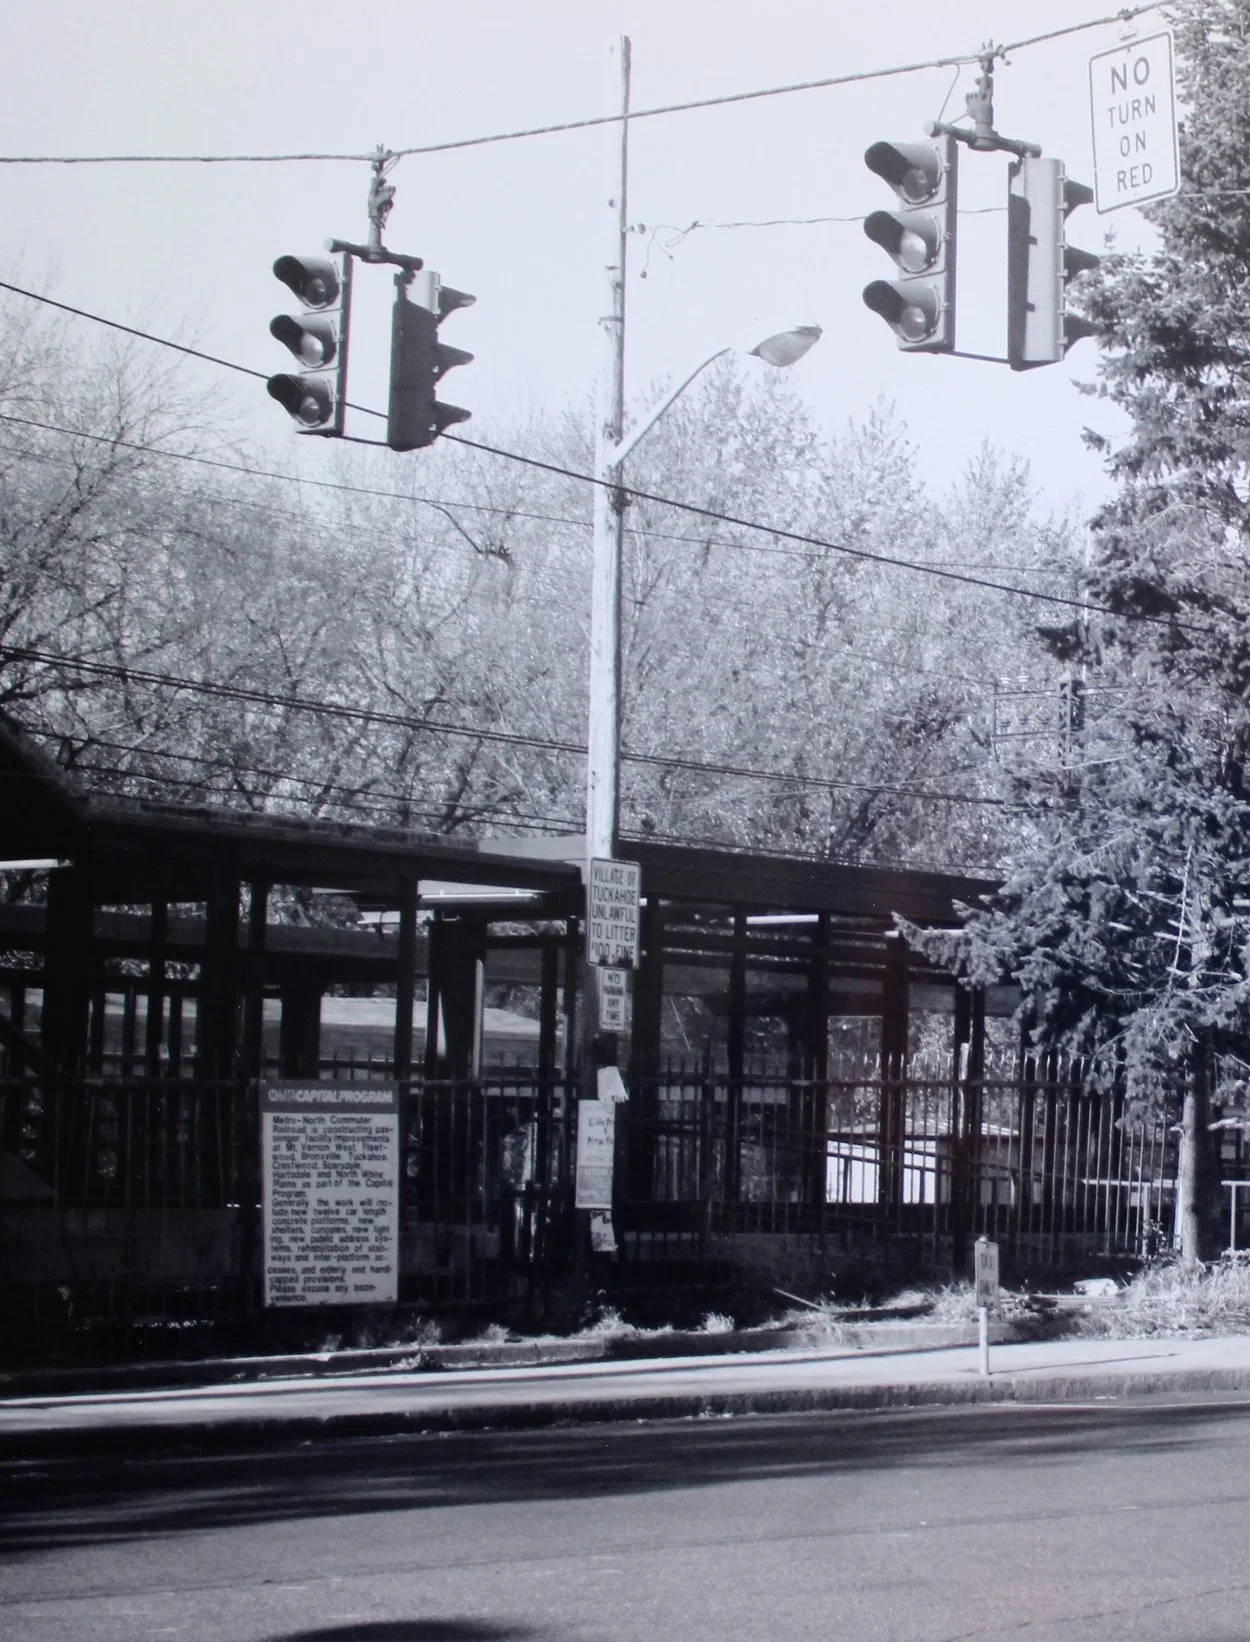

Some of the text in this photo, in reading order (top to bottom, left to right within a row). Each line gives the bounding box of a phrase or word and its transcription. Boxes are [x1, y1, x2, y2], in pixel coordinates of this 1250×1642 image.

[1111, 57, 1150, 94] NO
[1108, 94, 1156, 128] TURN
[1120, 130, 1146, 157] ON
[1117, 163, 1153, 192] RED
[592, 867, 637, 886] VILLAGE OF
[592, 885, 637, 906] TUCKAHOE
[591, 903, 636, 923] UNLAWFUL
[592, 922, 636, 942] TO LITTER
[616, 944, 635, 960] FINE
[608, 973, 620, 985] NO
[607, 998, 619, 1009] ANY
[606, 1010, 621, 1021] TIME
[296, 1089, 338, 1102] CAPITAL
[338, 1090, 394, 1103] PROGRAM
[330, 1116, 371, 1124] Commuter
[273, 1125, 306, 1133] Railroad
[323, 1126, 373, 1136] constructing
[302, 1143, 330, 1151] Vernon
[273, 1170, 311, 1179] Hartsdale
[336, 1170, 358, 1178] North
[316, 1180, 332, 1189] part
[334, 1179, 342, 1188] of
[348, 1179, 361, 1188] the
[366, 1178, 393, 1188] Capital
[317, 1199, 329, 1207] the
[335, 1199, 354, 1207] work
[291, 1208, 307, 1216] new
[311, 1235, 333, 1245] public
[301, 1265, 316, 1274] and
[320, 1265, 346, 1276] elderly
